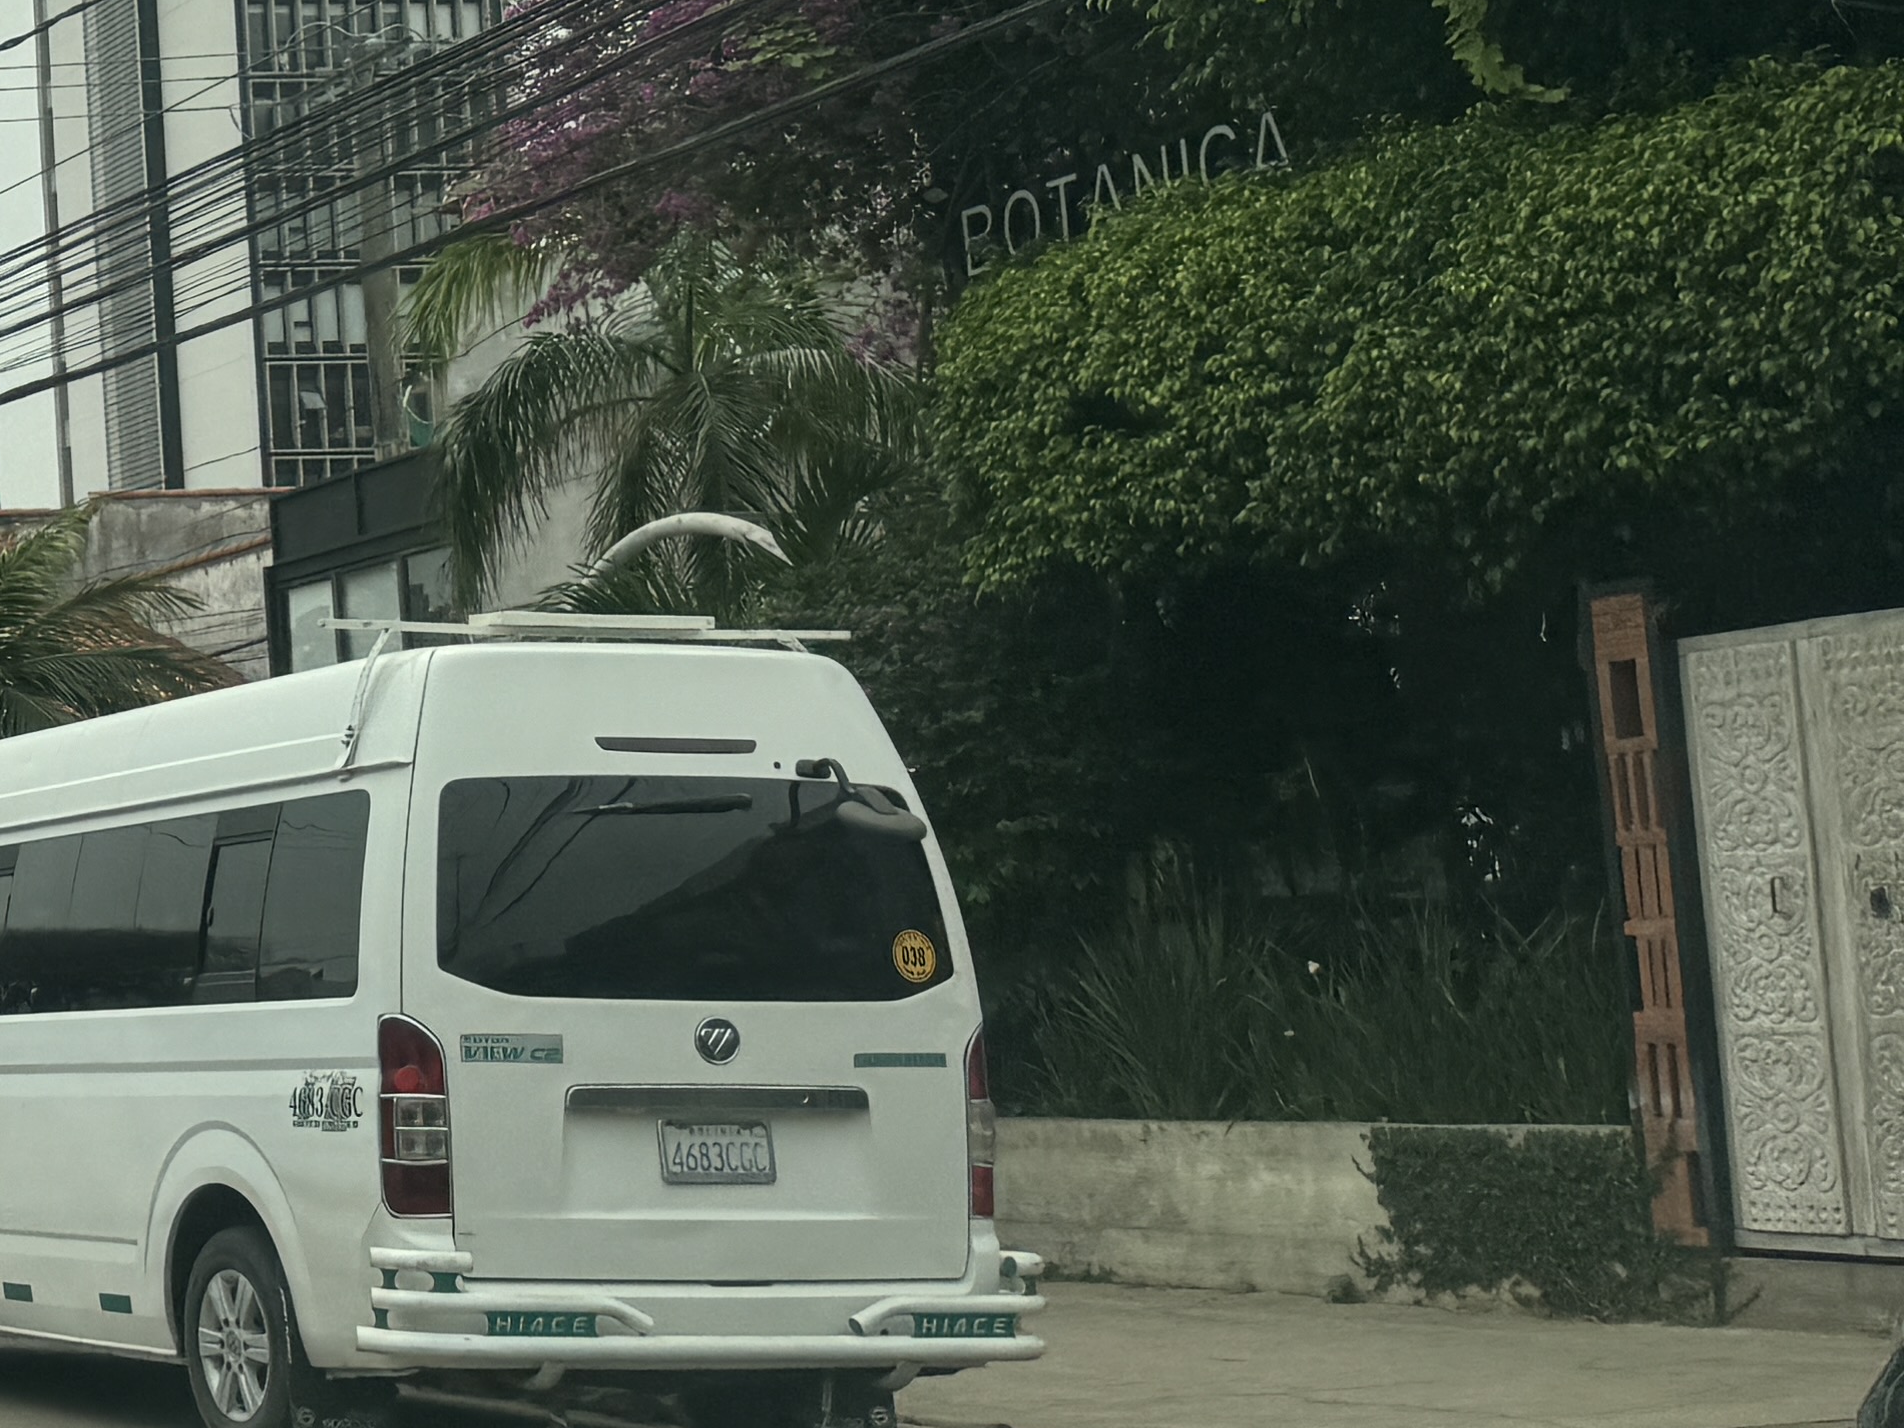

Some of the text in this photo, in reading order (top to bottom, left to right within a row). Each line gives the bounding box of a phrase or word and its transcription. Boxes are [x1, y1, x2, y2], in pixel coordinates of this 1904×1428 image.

[672, 1141, 769, 1173] 4683CGC
[495, 1315, 588, 1333] HIACE
[922, 1317, 1009, 1334] HIACE
